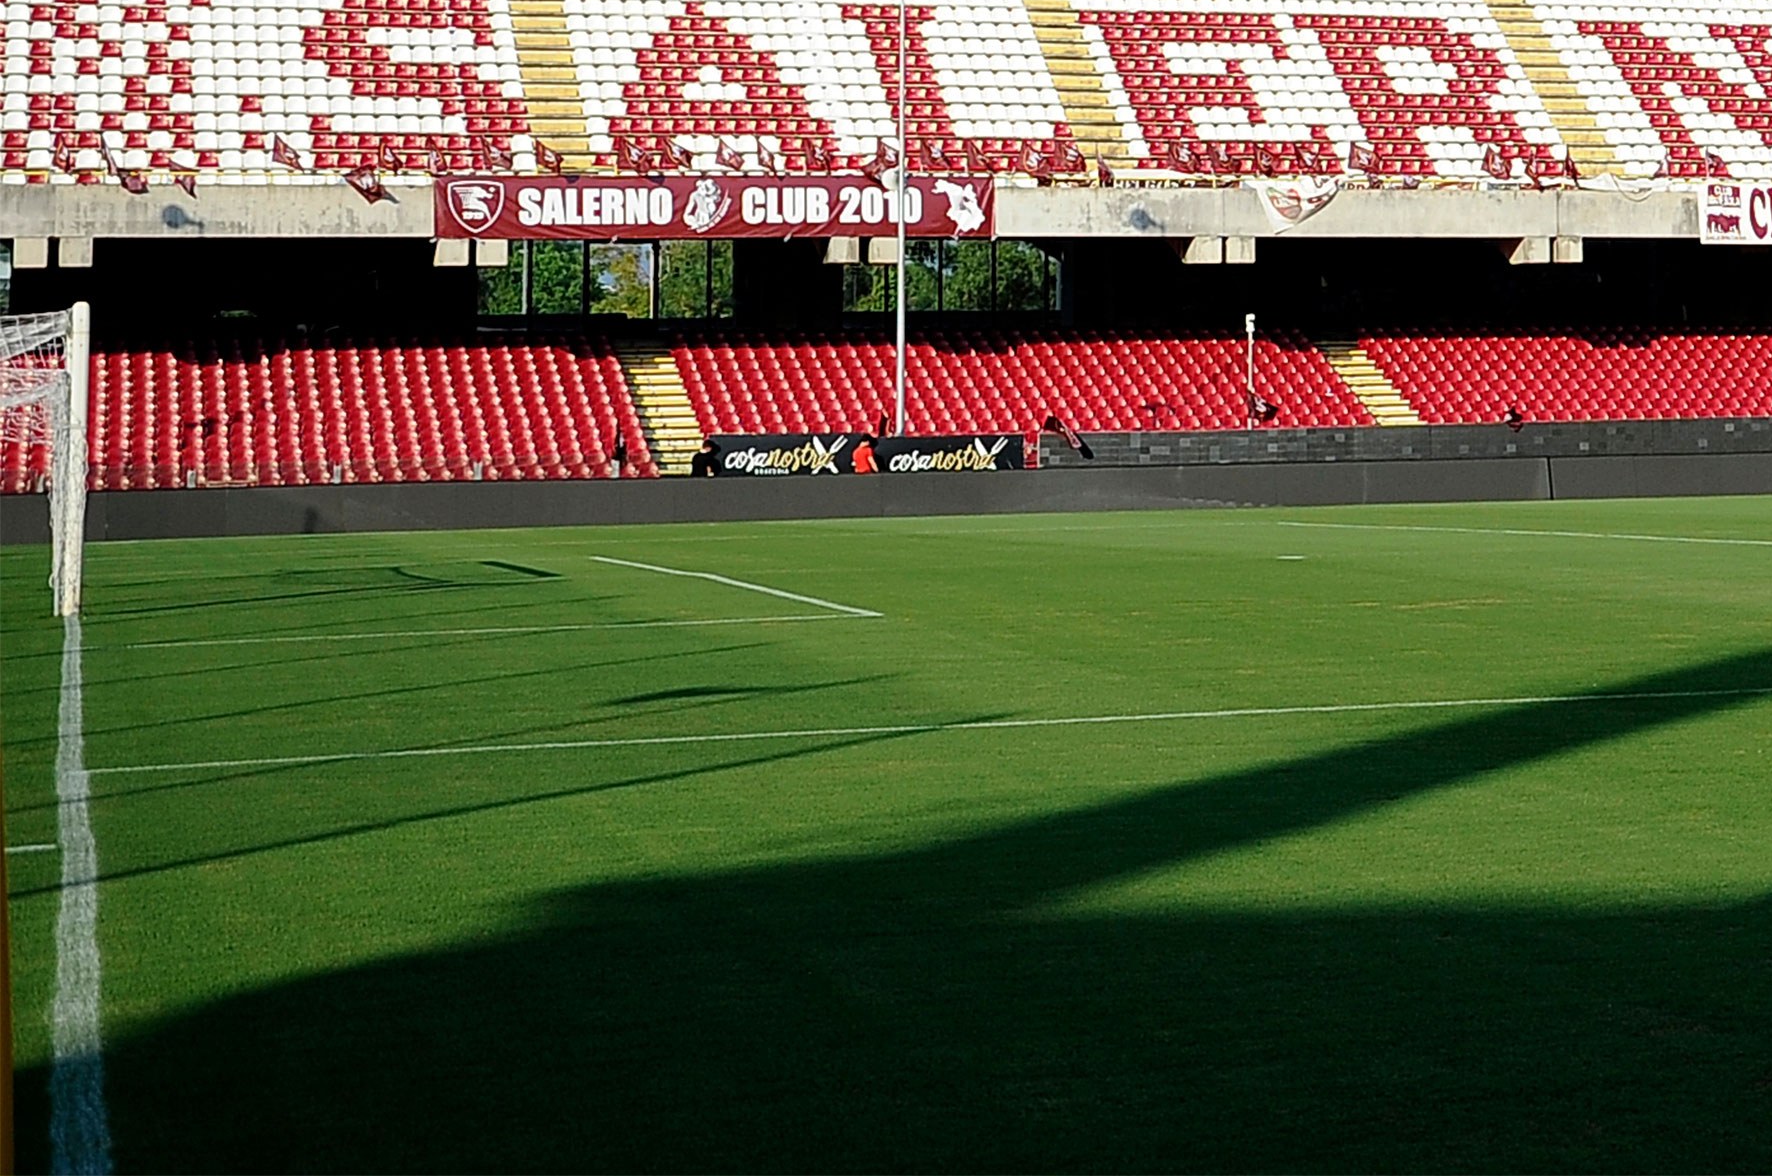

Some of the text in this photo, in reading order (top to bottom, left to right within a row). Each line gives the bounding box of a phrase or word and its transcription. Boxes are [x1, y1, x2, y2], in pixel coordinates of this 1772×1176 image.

[517, 187, 673, 226] SALERNO
[741, 187, 830, 225] CLUB
[838, 187, 924, 225] 2010
